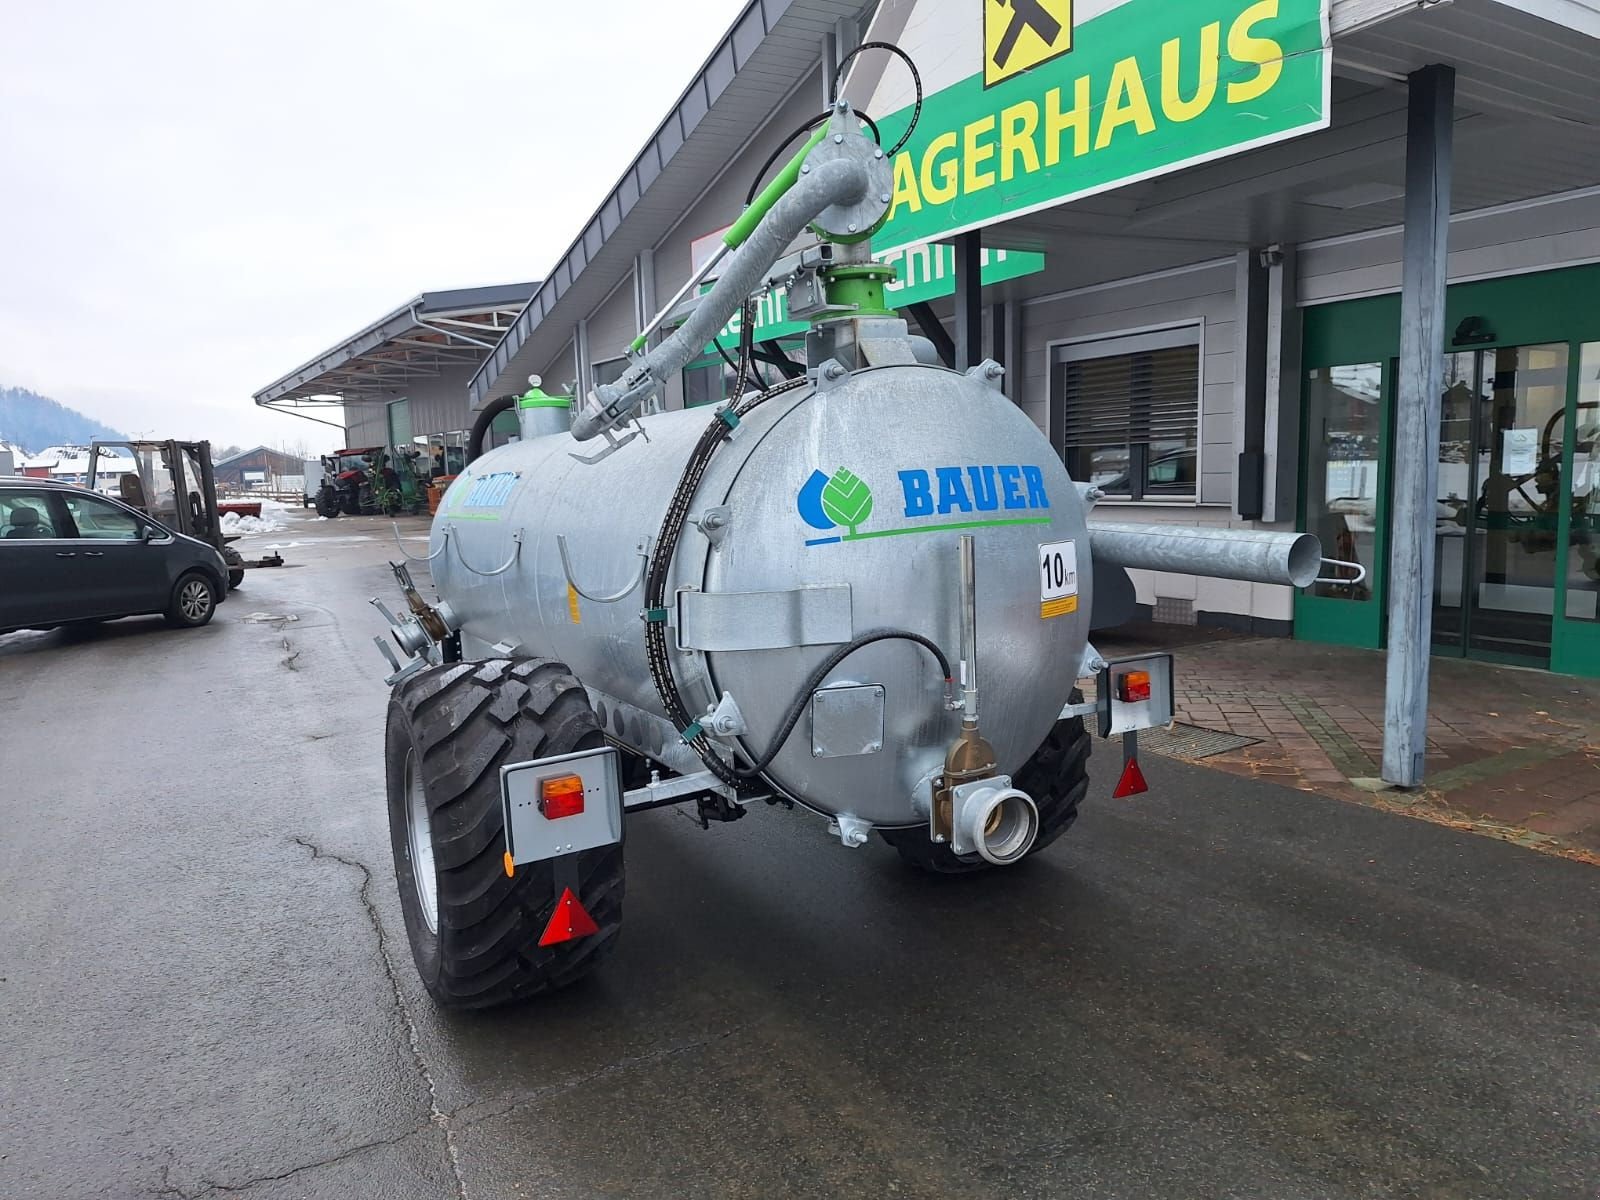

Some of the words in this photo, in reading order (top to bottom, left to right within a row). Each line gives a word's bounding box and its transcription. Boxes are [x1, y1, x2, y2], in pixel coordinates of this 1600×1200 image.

[887, 0, 1283, 221] AGERHAUS
[897, 465, 1049, 517] BAUER
[1043, 552, 1063, 589] 10
